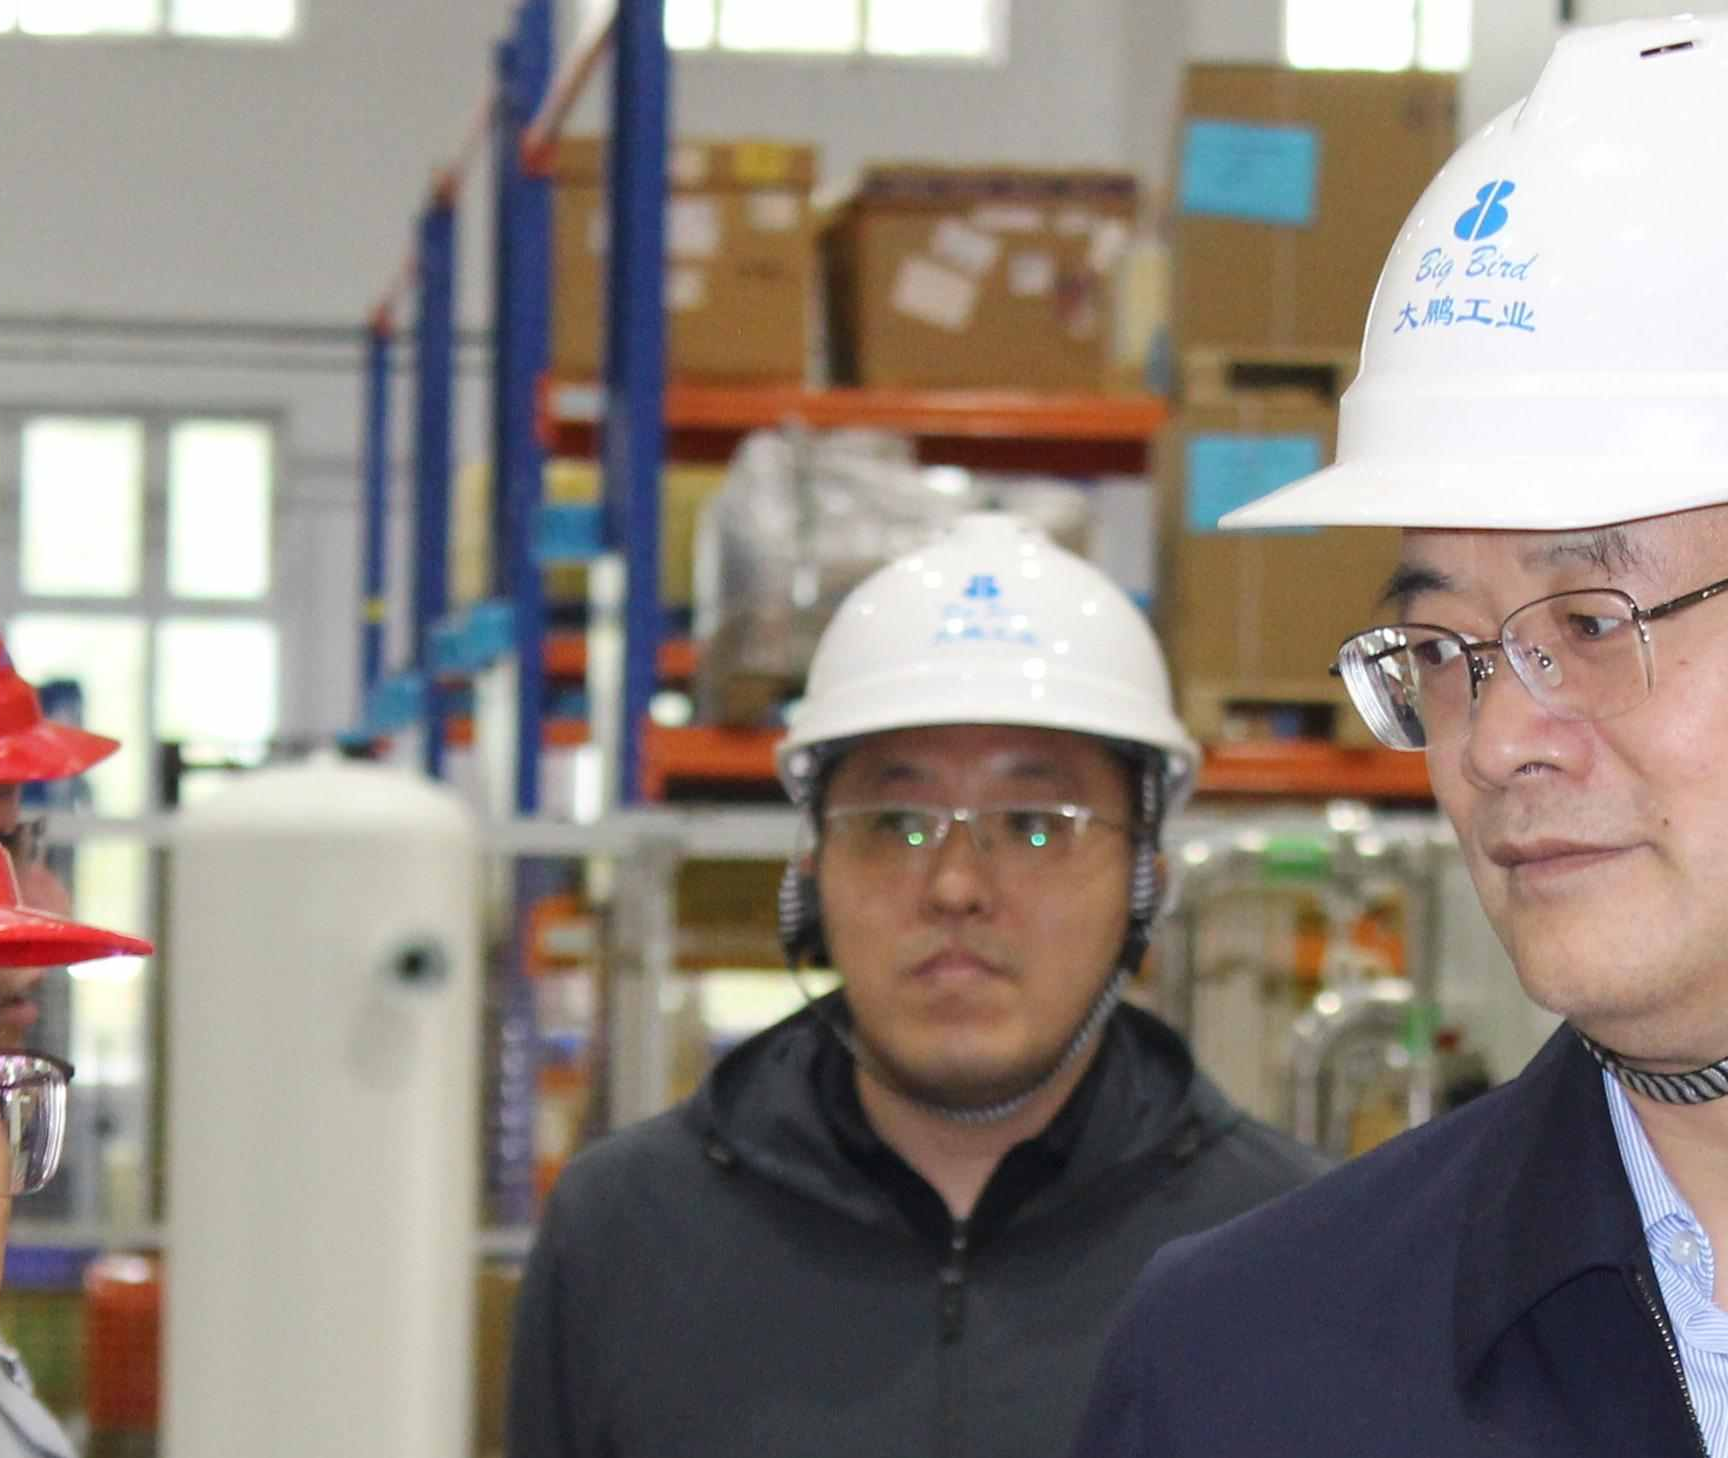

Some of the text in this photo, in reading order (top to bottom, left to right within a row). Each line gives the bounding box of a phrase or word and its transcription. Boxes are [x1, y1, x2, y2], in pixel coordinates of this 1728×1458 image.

[1415, 244, 1539, 288] Big Bird
[1393, 296, 1536, 334] 大鹏工业
